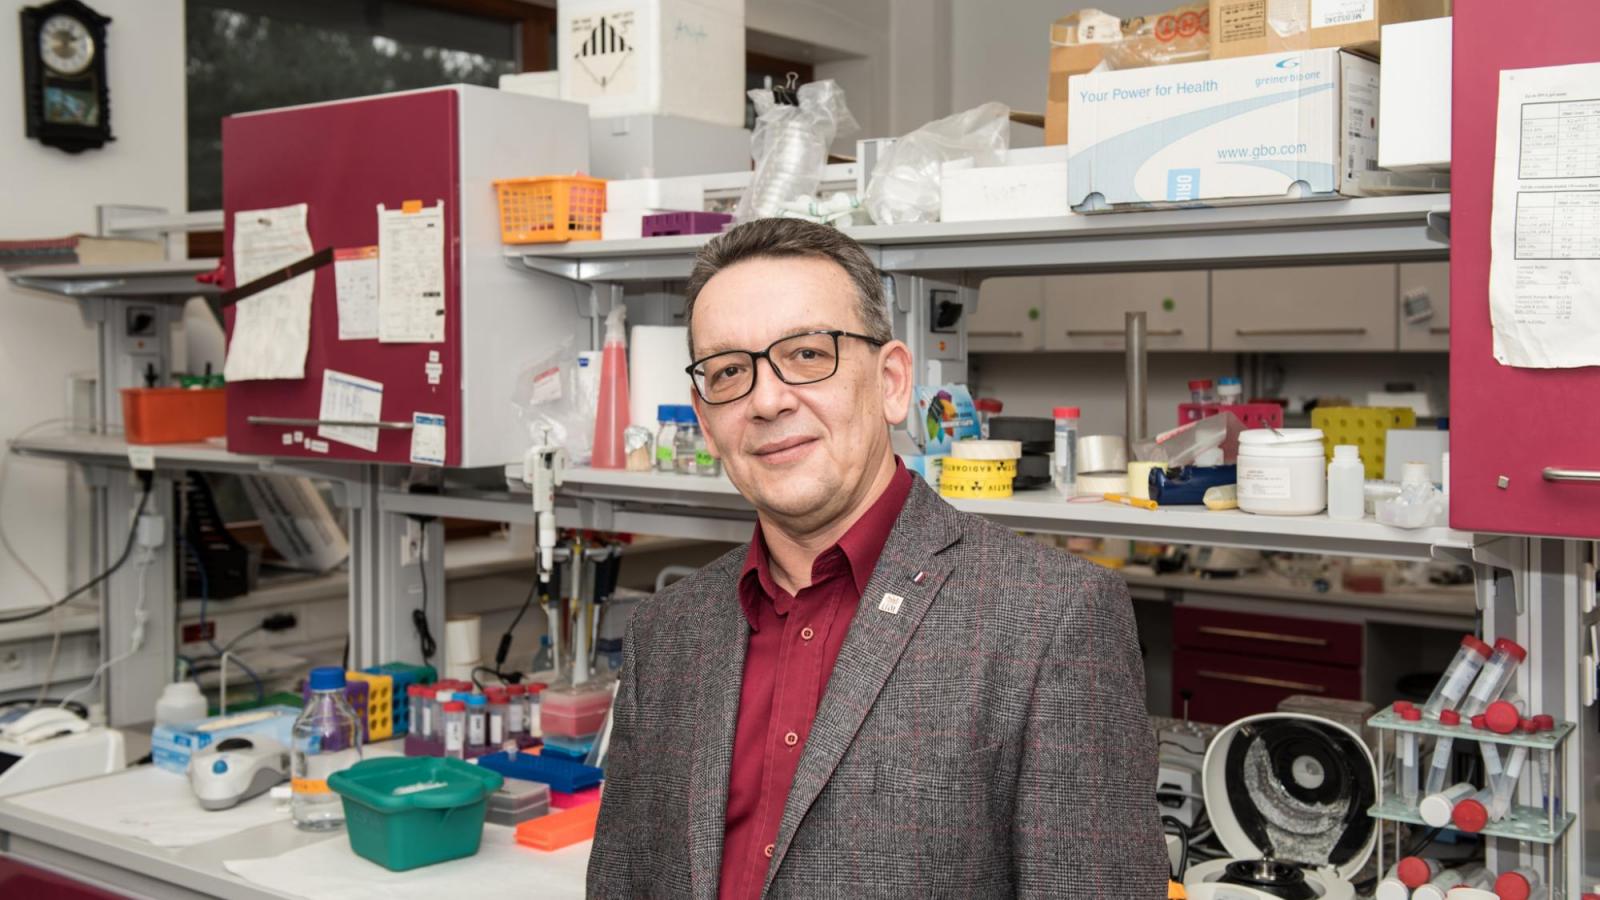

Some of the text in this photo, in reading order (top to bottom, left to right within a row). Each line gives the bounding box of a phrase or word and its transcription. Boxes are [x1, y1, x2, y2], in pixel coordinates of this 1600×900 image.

[1080, 79, 1219, 103] Your Power for Health
[1217, 143, 1307, 160] www.gbo.com
